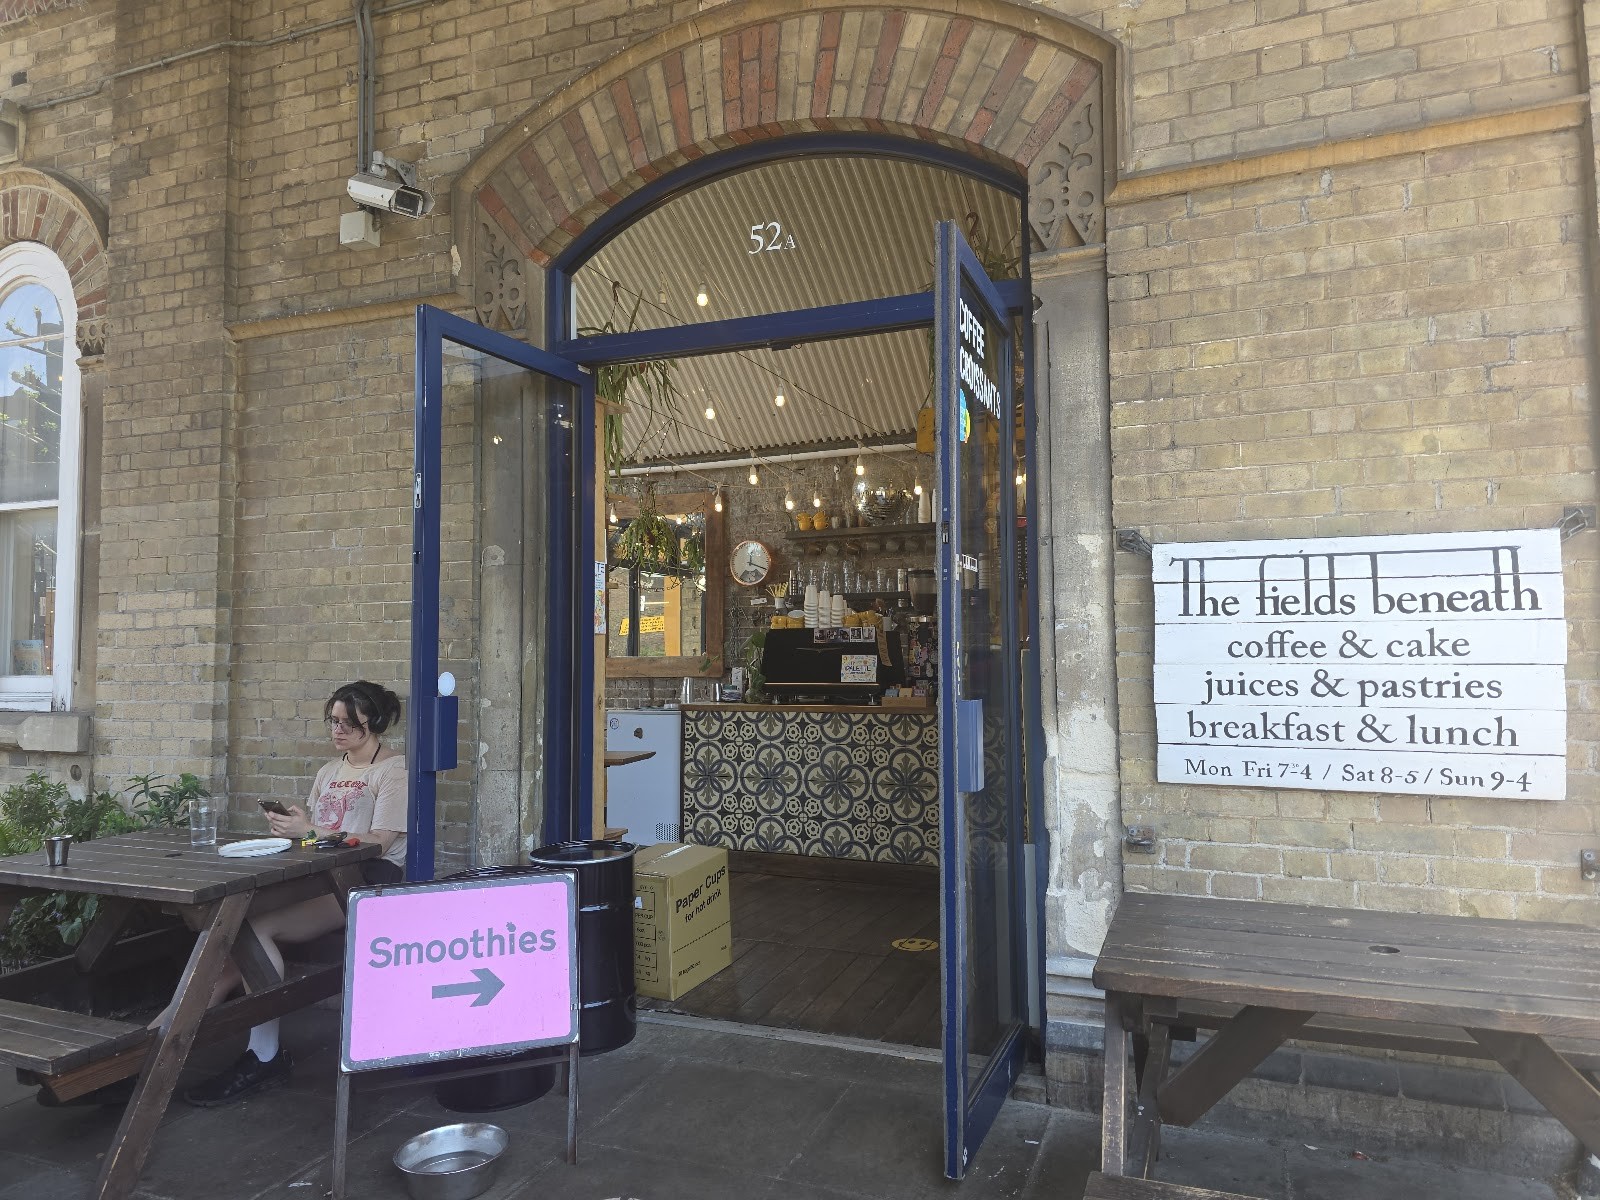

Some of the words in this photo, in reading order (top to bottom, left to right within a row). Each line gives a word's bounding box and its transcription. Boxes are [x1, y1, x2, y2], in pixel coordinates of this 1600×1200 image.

[959, 297, 985, 360] COFFEE
[959, 345, 1001, 420] CROISSANTS
[1169, 556, 1241, 617] The
[1255, 550, 1356, 617] fields
[1369, 545, 1543, 615] beneath
[1226, 629, 1328, 659] coffee
[1338, 629, 1378, 659] &
[1386, 628, 1472, 658] cake
[1200, 670, 1300, 705] juices
[1310, 668, 1350, 698] &
[1356, 671, 1503, 707] pastries
[1186, 711, 1346, 743] breakfast
[1356, 713, 1398, 744] &
[1405, 714, 1520, 747] lunch
[1184, 758, 1233, 777] Mon
[1242, 760, 1273, 778] Fri
[1341, 763, 1376, 782] Sat
[1440, 767, 1486, 788] Sun
[1490, 771, 1533, 793] 9-4
[676, 884, 704, 914] Paper
[705, 865, 726, 889] Cups
[685, 910, 695, 923] for
[695, 900, 706, 915] hot
[368, 921, 557, 969] Smoothies
